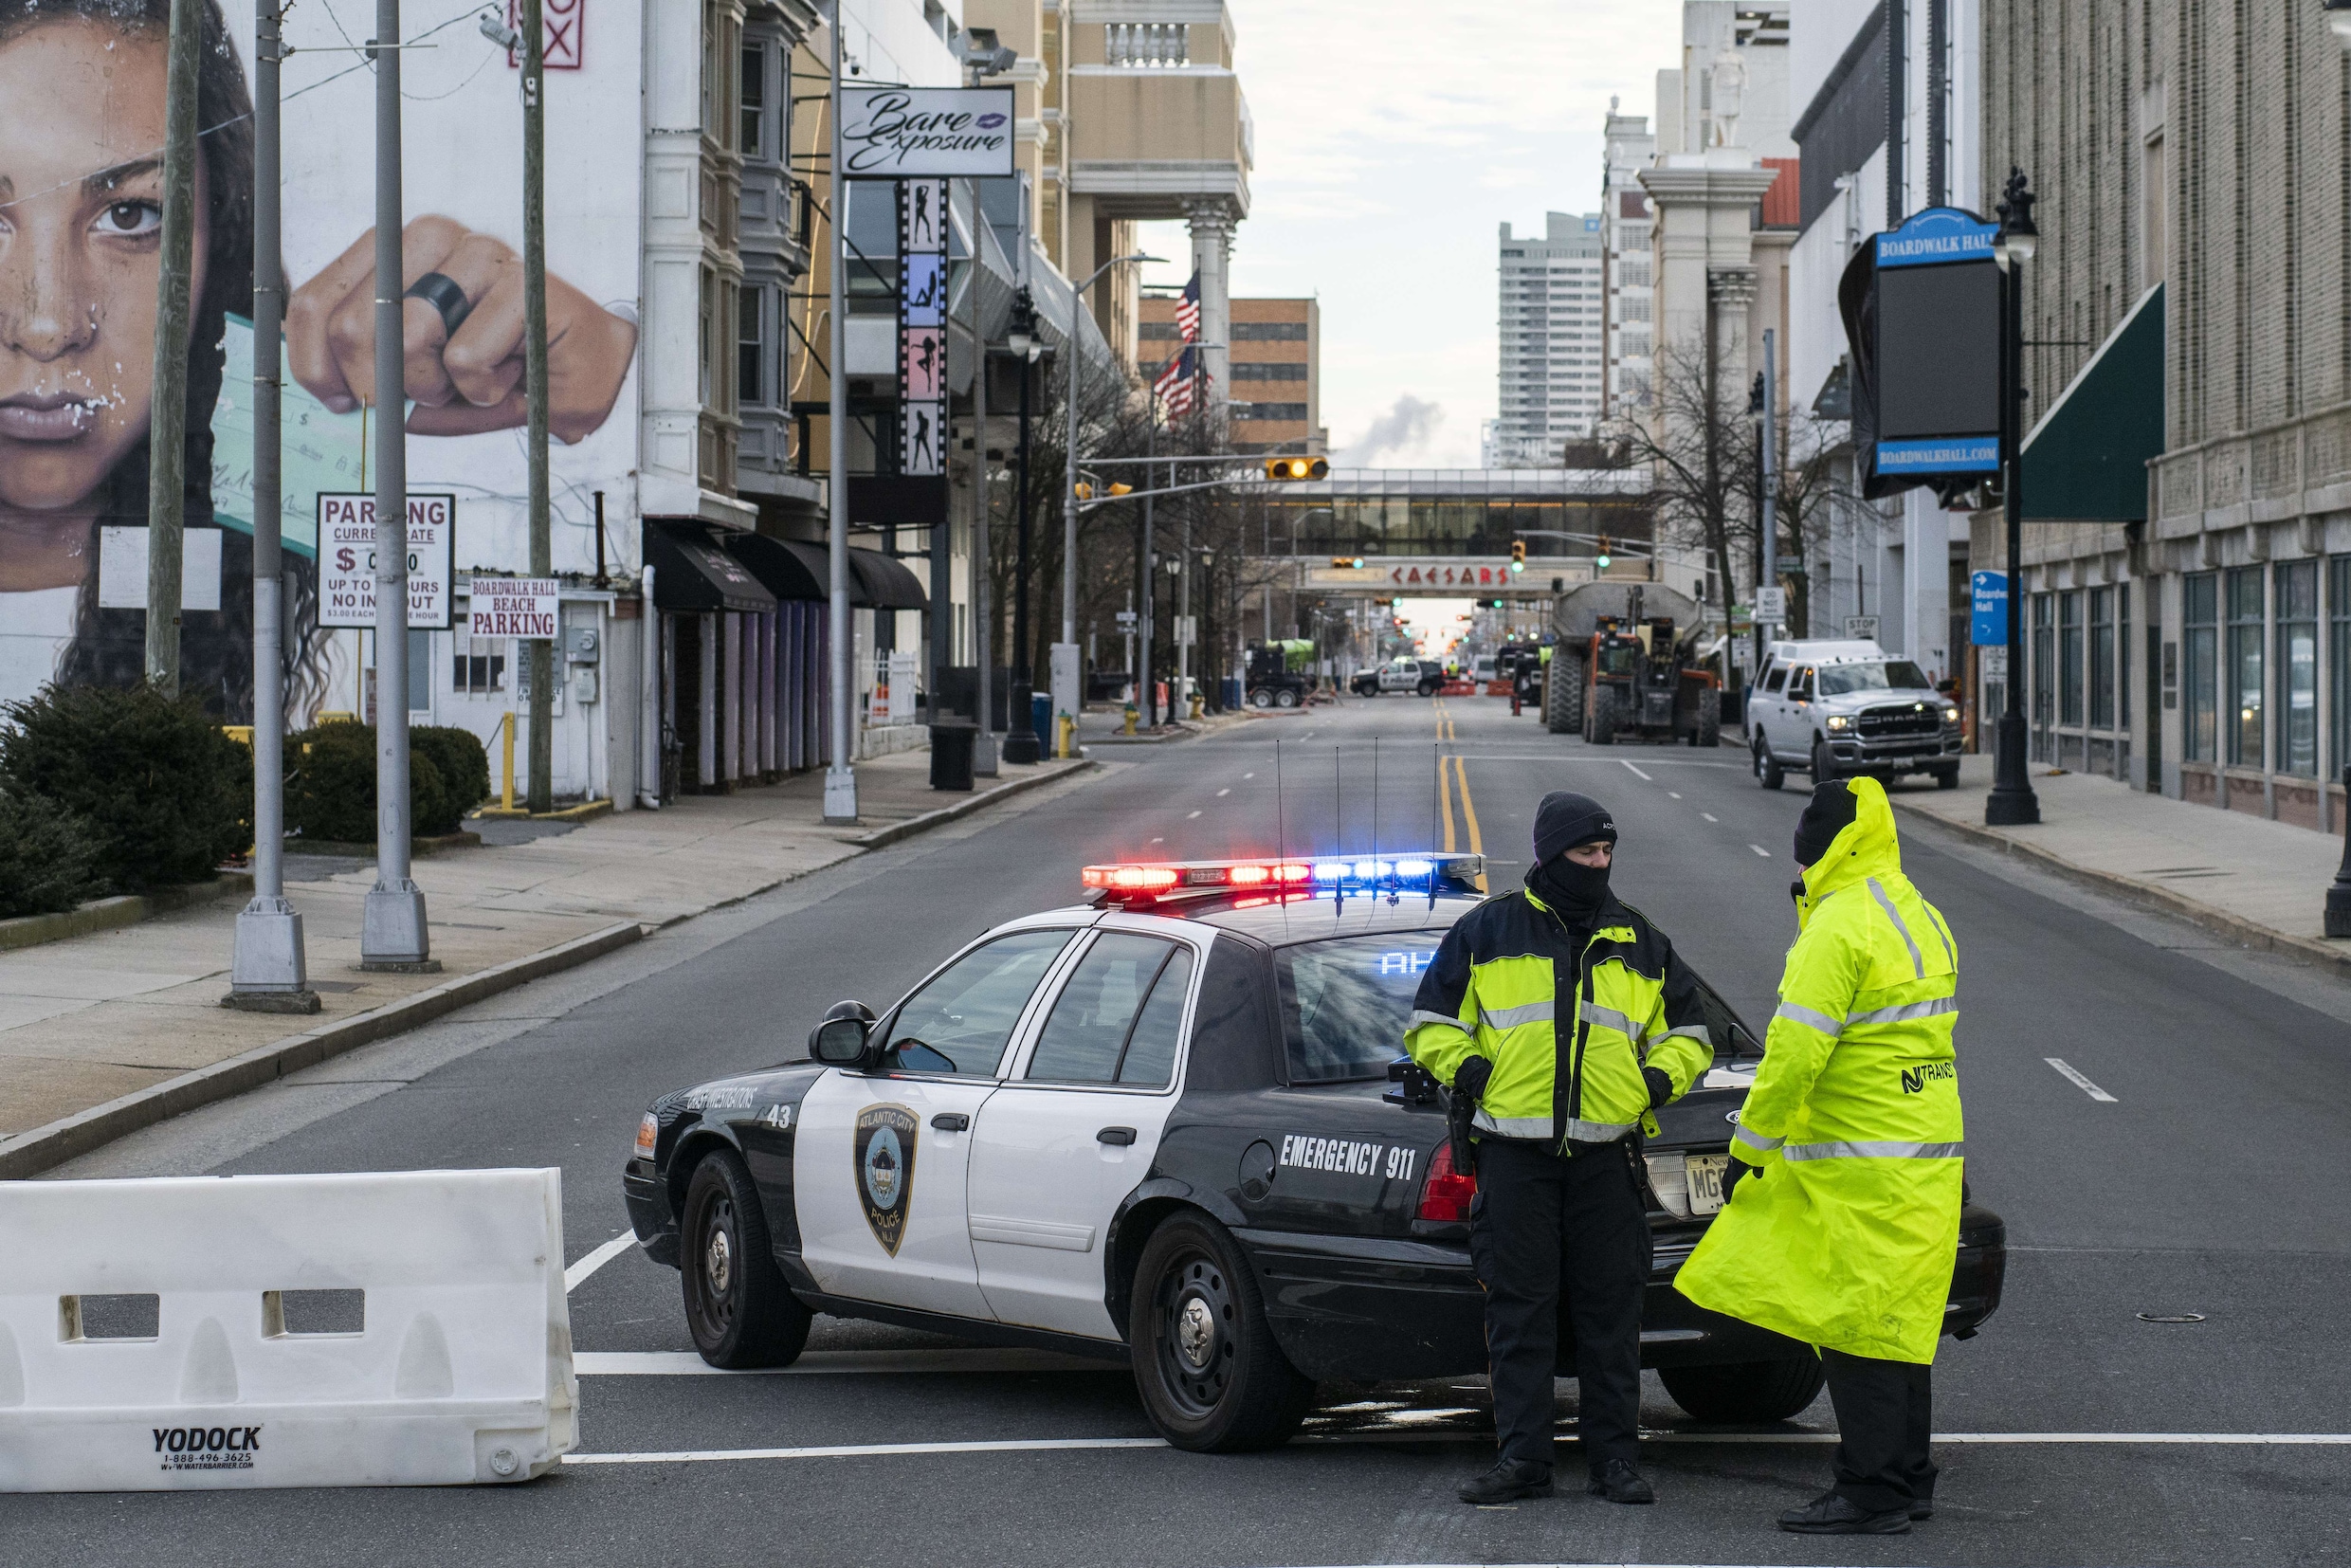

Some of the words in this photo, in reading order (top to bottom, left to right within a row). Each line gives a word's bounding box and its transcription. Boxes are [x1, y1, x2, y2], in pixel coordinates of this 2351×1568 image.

[866, 92, 973, 139] Bare
[843, 121, 1005, 171] Exposure
[1880, 235, 1959, 258] BOARDWALK
[1879, 447, 1996, 465] BOARDWALKHALL.COM
[325, 501, 445, 524] PARNG
[334, 528, 376, 539] CURRE
[407, 529, 434, 540] ATE
[1392, 566, 1507, 585] CAESARS
[328, 579, 346, 591] UP
[352, 580, 371, 591] TO
[408, 582, 439, 593] URS
[473, 581, 529, 595] BOARDWALK
[532, 582, 556, 596] HALL
[333, 594, 355, 607] NO
[407, 596, 434, 610] UT
[493, 597, 536, 611] BEACH
[1975, 601, 1994, 612] Hall
[473, 612, 554, 635] PARKING
[1849, 619, 1875, 629] STOP
[1921, 1062, 1955, 1082] TRANS
[767, 1103, 791, 1129] 43
[859, 1110, 896, 1130] ATLANTIC
[897, 1114, 915, 1134] CITY
[1280, 1134, 1383, 1176] EMERGENCY
[1386, 1146, 1416, 1181] 911
[870, 1207, 901, 1229] POLICE
[882, 1231, 895, 1243] N.J.
[153, 1427, 261, 1452] YODOCK
[165, 1452, 251, 1463] 1-888-496-3625
